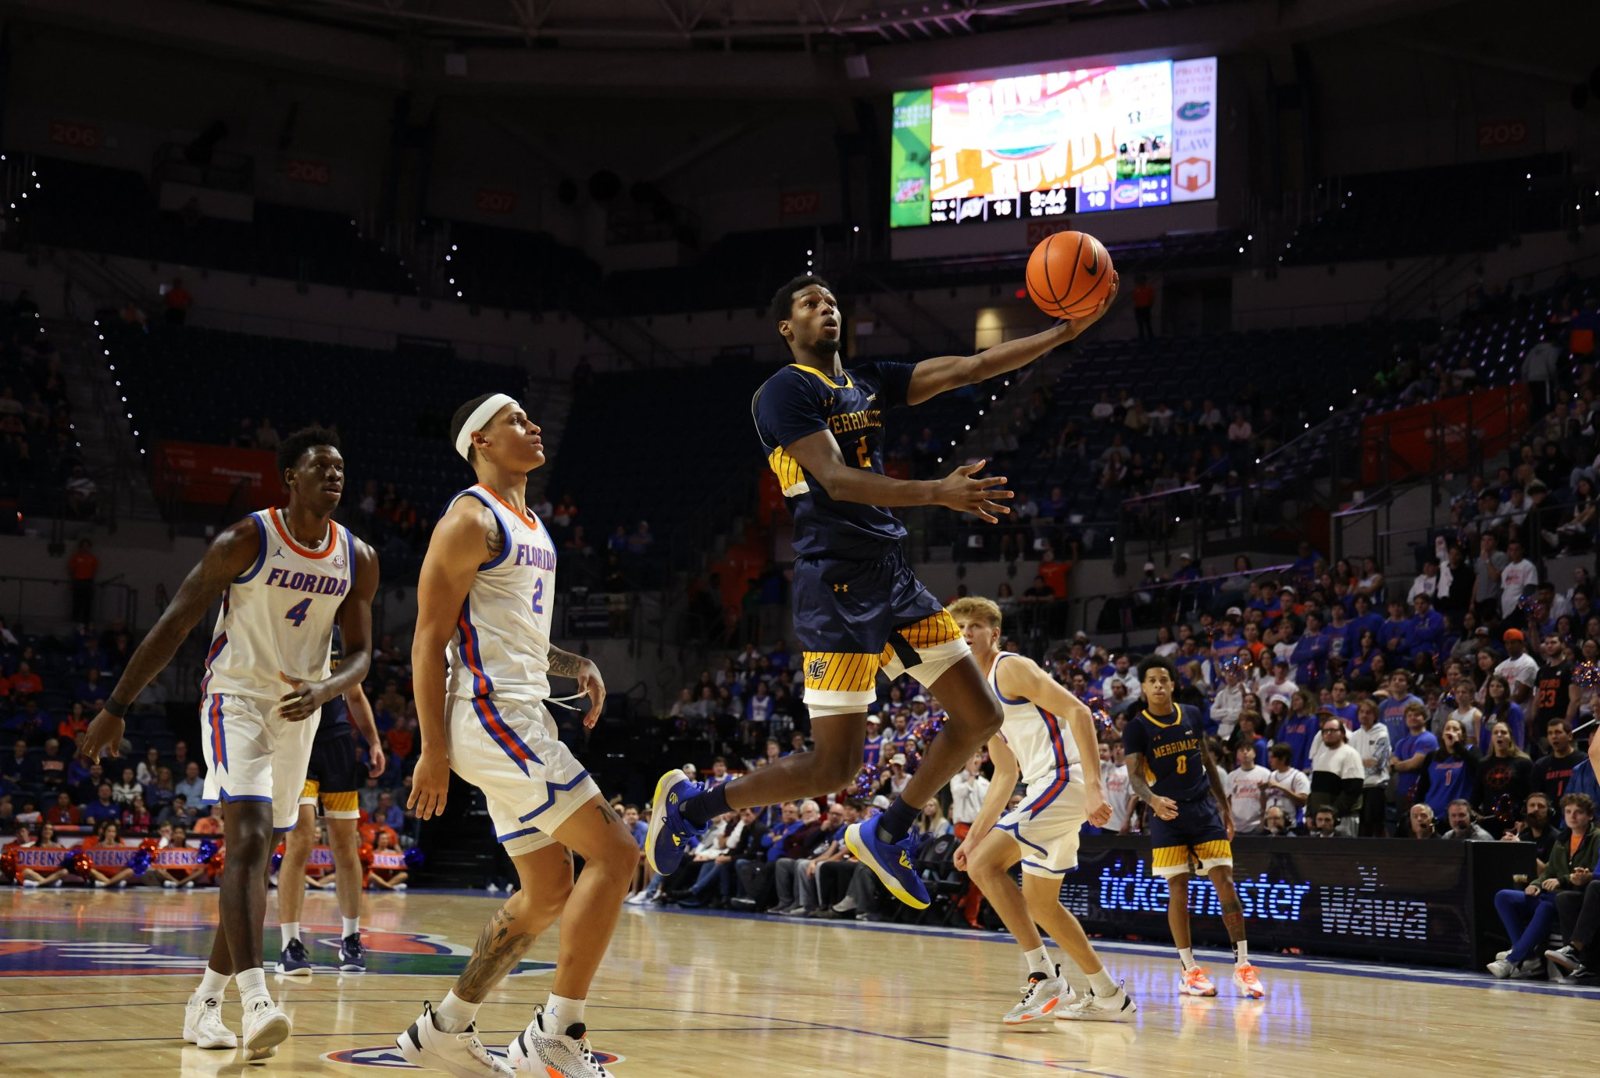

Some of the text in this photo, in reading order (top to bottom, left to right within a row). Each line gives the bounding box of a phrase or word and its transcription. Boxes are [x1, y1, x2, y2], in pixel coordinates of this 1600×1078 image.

[52, 124, 96, 146] 206
[1175, 137, 1211, 152] LAW
[1480, 122, 1526, 145] 209
[479, 191, 513, 212] 207
[783, 194, 817, 213] 207
[265, 567, 347, 597] FLORIDA
[532, 576, 543, 615] 2
[285, 597, 313, 627] 4
[1175, 754, 1188, 775] 0
[1099, 859, 1310, 920] tickemster
